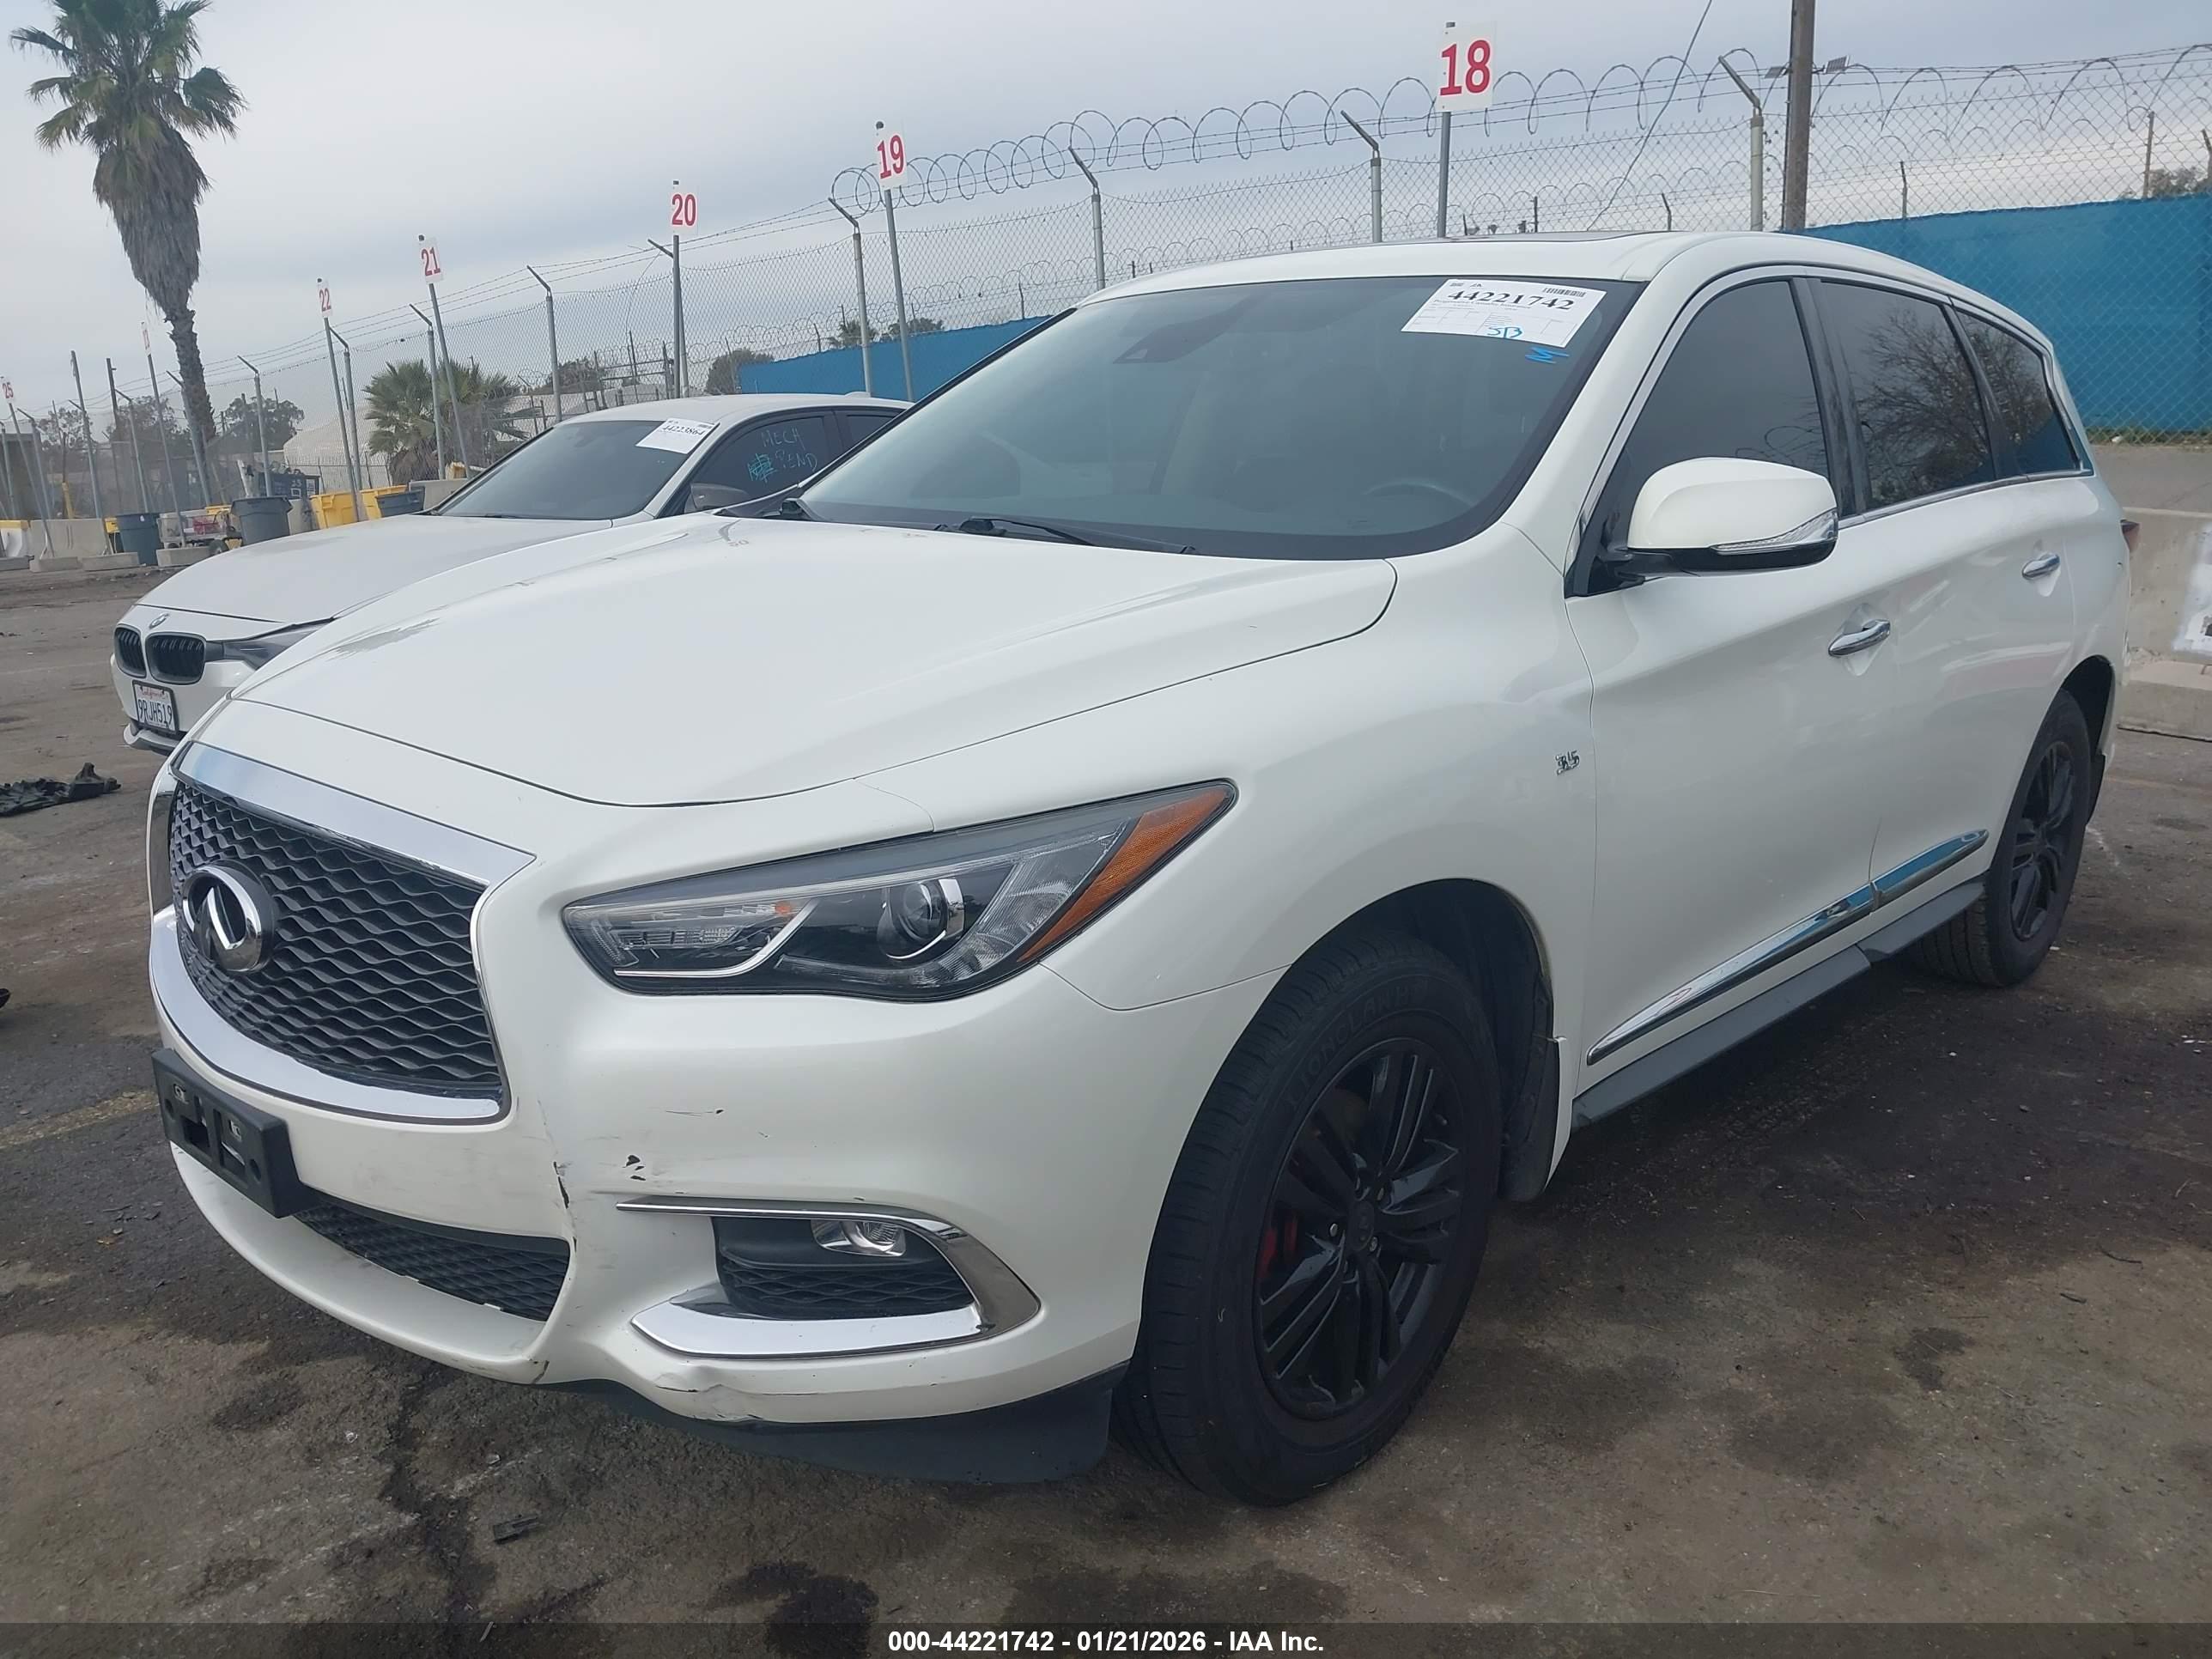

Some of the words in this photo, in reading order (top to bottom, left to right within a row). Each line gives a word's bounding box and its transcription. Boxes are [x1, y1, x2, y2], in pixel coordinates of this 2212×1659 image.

[1440, 40, 1491, 96] 18
[877, 135, 904, 179] 19
[672, 193, 696, 226] 20
[421, 247, 441, 276] 21
[319, 288, 331, 312] 22
[1448, 289, 1574, 310] 44221742
[3, 382, 14, 398] 25
[761, 427, 806, 451] MECH
[137, 698, 173, 726] 9RJH519
